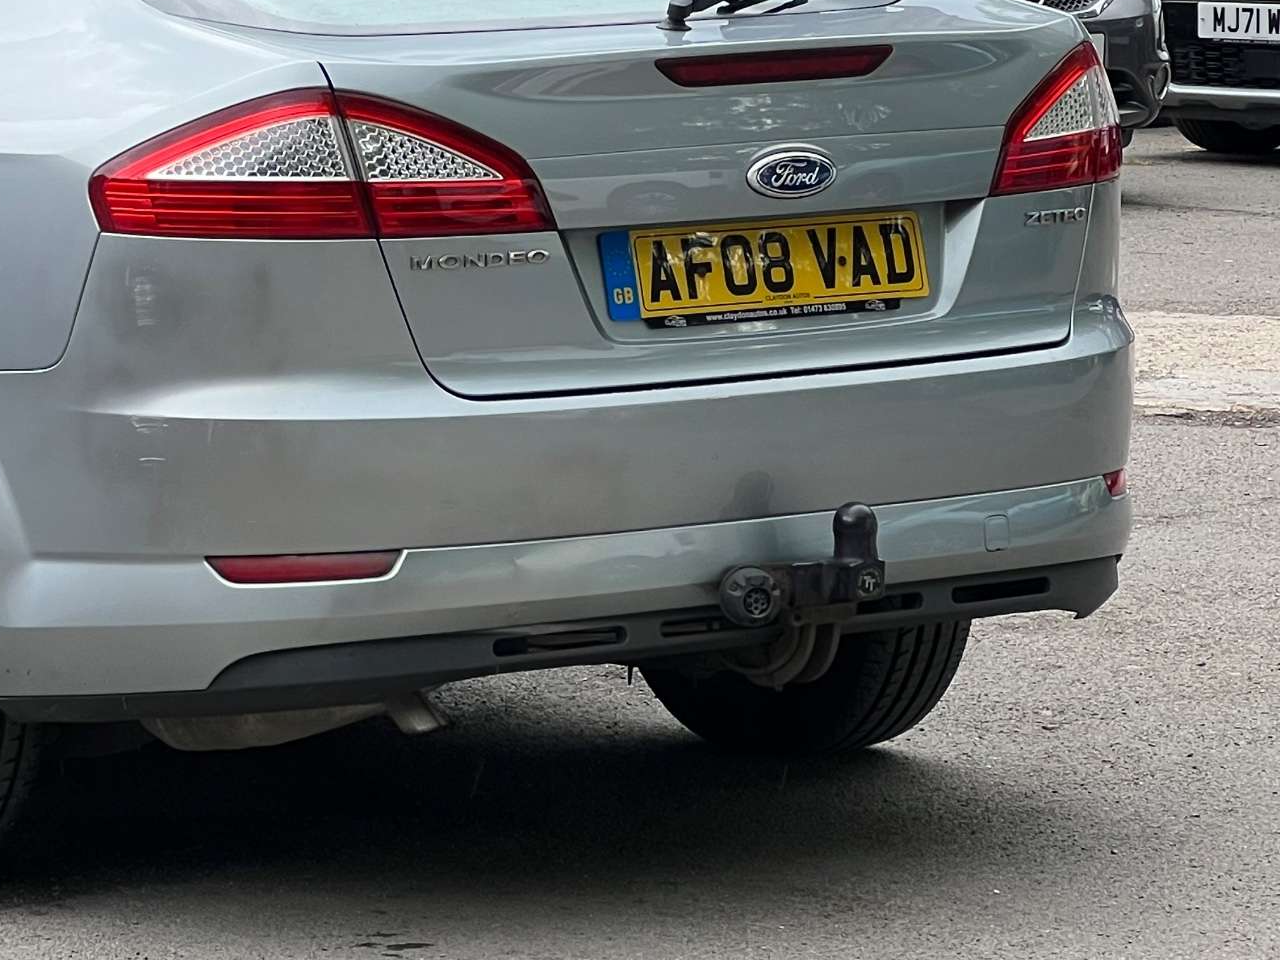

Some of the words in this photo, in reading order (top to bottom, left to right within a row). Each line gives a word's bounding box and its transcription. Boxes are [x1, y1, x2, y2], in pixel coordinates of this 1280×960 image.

[1213, 7, 1260, 33] MJ71
[1268, 8, 1280, 34] W
[771, 161, 820, 188] Ford
[1024, 207, 1087, 226] ZETEC
[410, 248, 550, 271] MONDEO
[651, 232, 795, 303] AF08
[806, 223, 916, 289] VAD
[613, 287, 634, 304] GB
